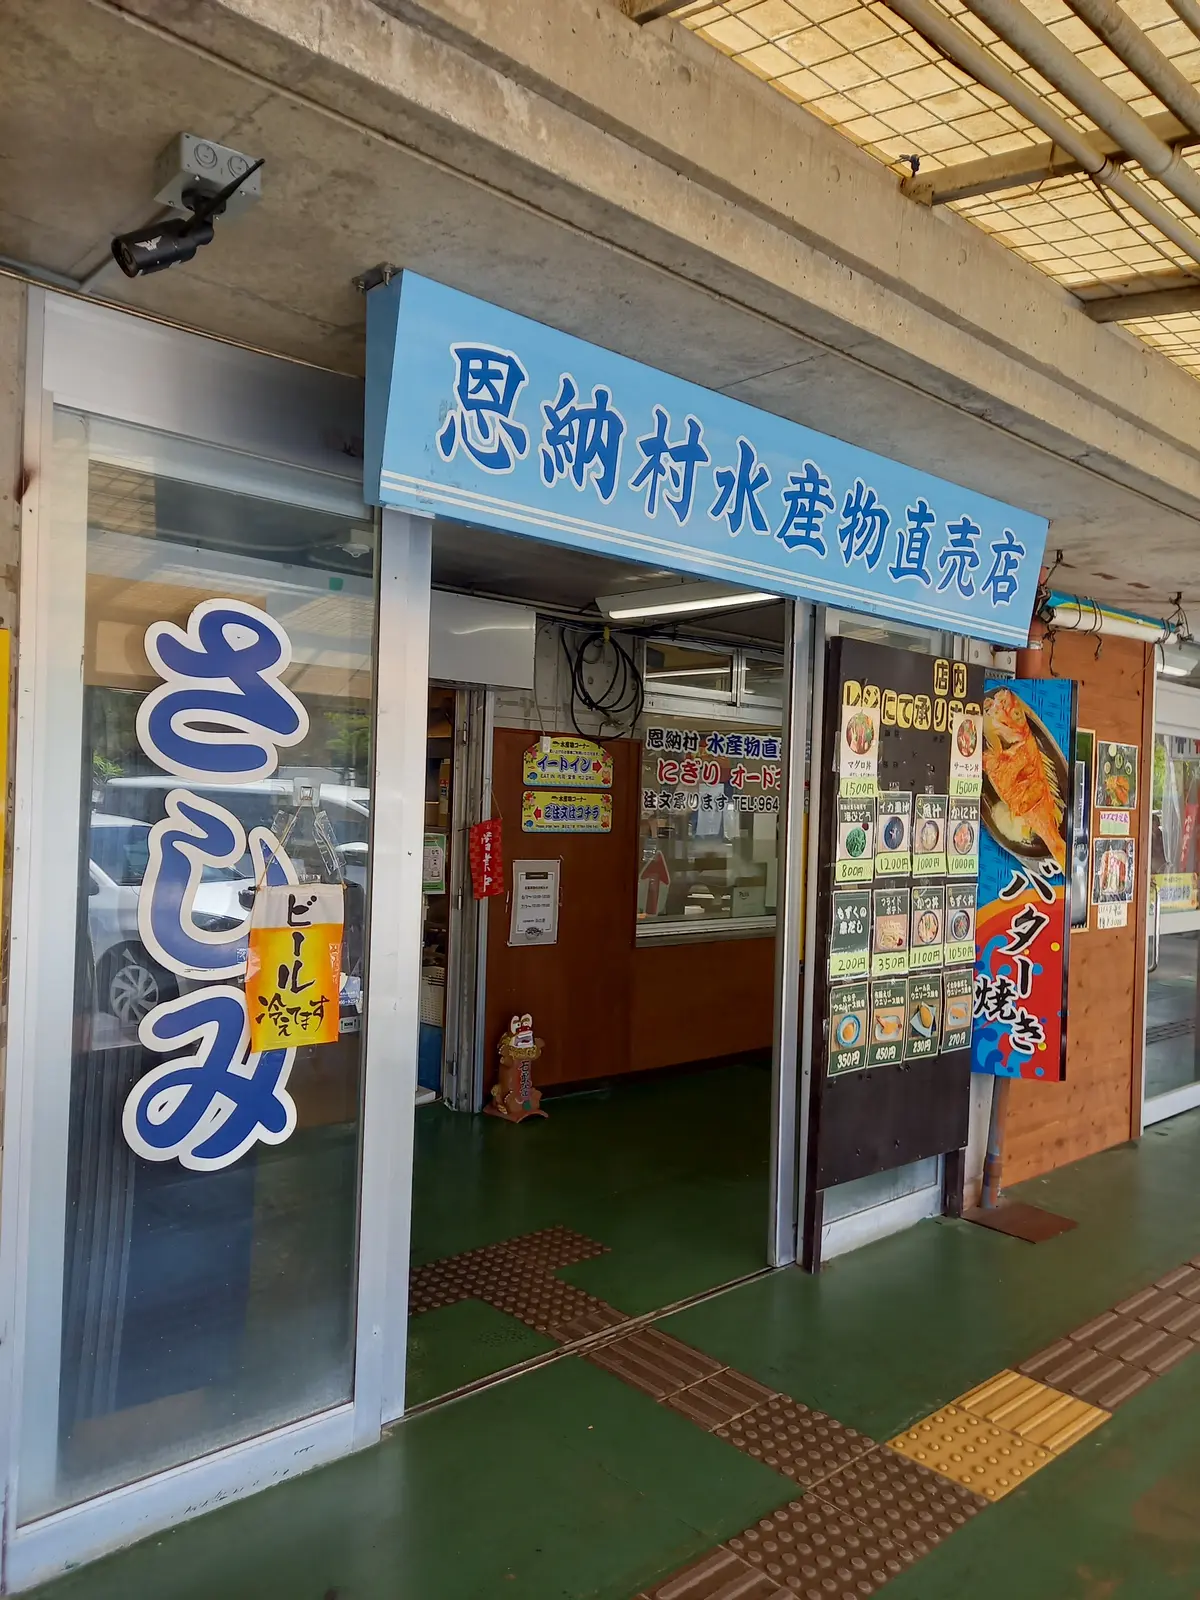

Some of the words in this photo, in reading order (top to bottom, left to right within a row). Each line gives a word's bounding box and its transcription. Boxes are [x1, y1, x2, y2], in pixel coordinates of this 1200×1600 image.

[436, 342, 1028, 608] 恩納村水産物直売店
[935, 660, 966, 696] 店内
[647, 727, 699, 752] 恩納村
[706, 731, 781, 759] 水産物直
[537, 754, 591, 773] イートイン
[658, 758, 720, 786] にぎり
[845, 781, 874, 795] 1500円
[956, 782, 979, 794] 1500円
[643, 791, 728, 811] 注文承ります
[544, 803, 600, 821] ご注文はコチラ
[951, 807, 978, 819] かに汁
[842, 864, 863, 877] 800円
[880, 857, 909, 870] 1200円
[951, 858, 975, 870] 1000円
[122, 598, 309, 1171] さしみ
[837, 905, 867, 920] もずくの
[277, 893, 318, 994] ビール
[913, 951, 940, 964] 1100円
[949, 946, 974, 959] 1050円
[839, 958, 866, 971] 200円
[879, 957, 905, 971] 350円
[913, 1039, 931, 1053] 230円
[948, 1032, 967, 1046] 270円
[837, 1050, 860, 1069] 350円
[875, 1045, 896, 1060] 450円
